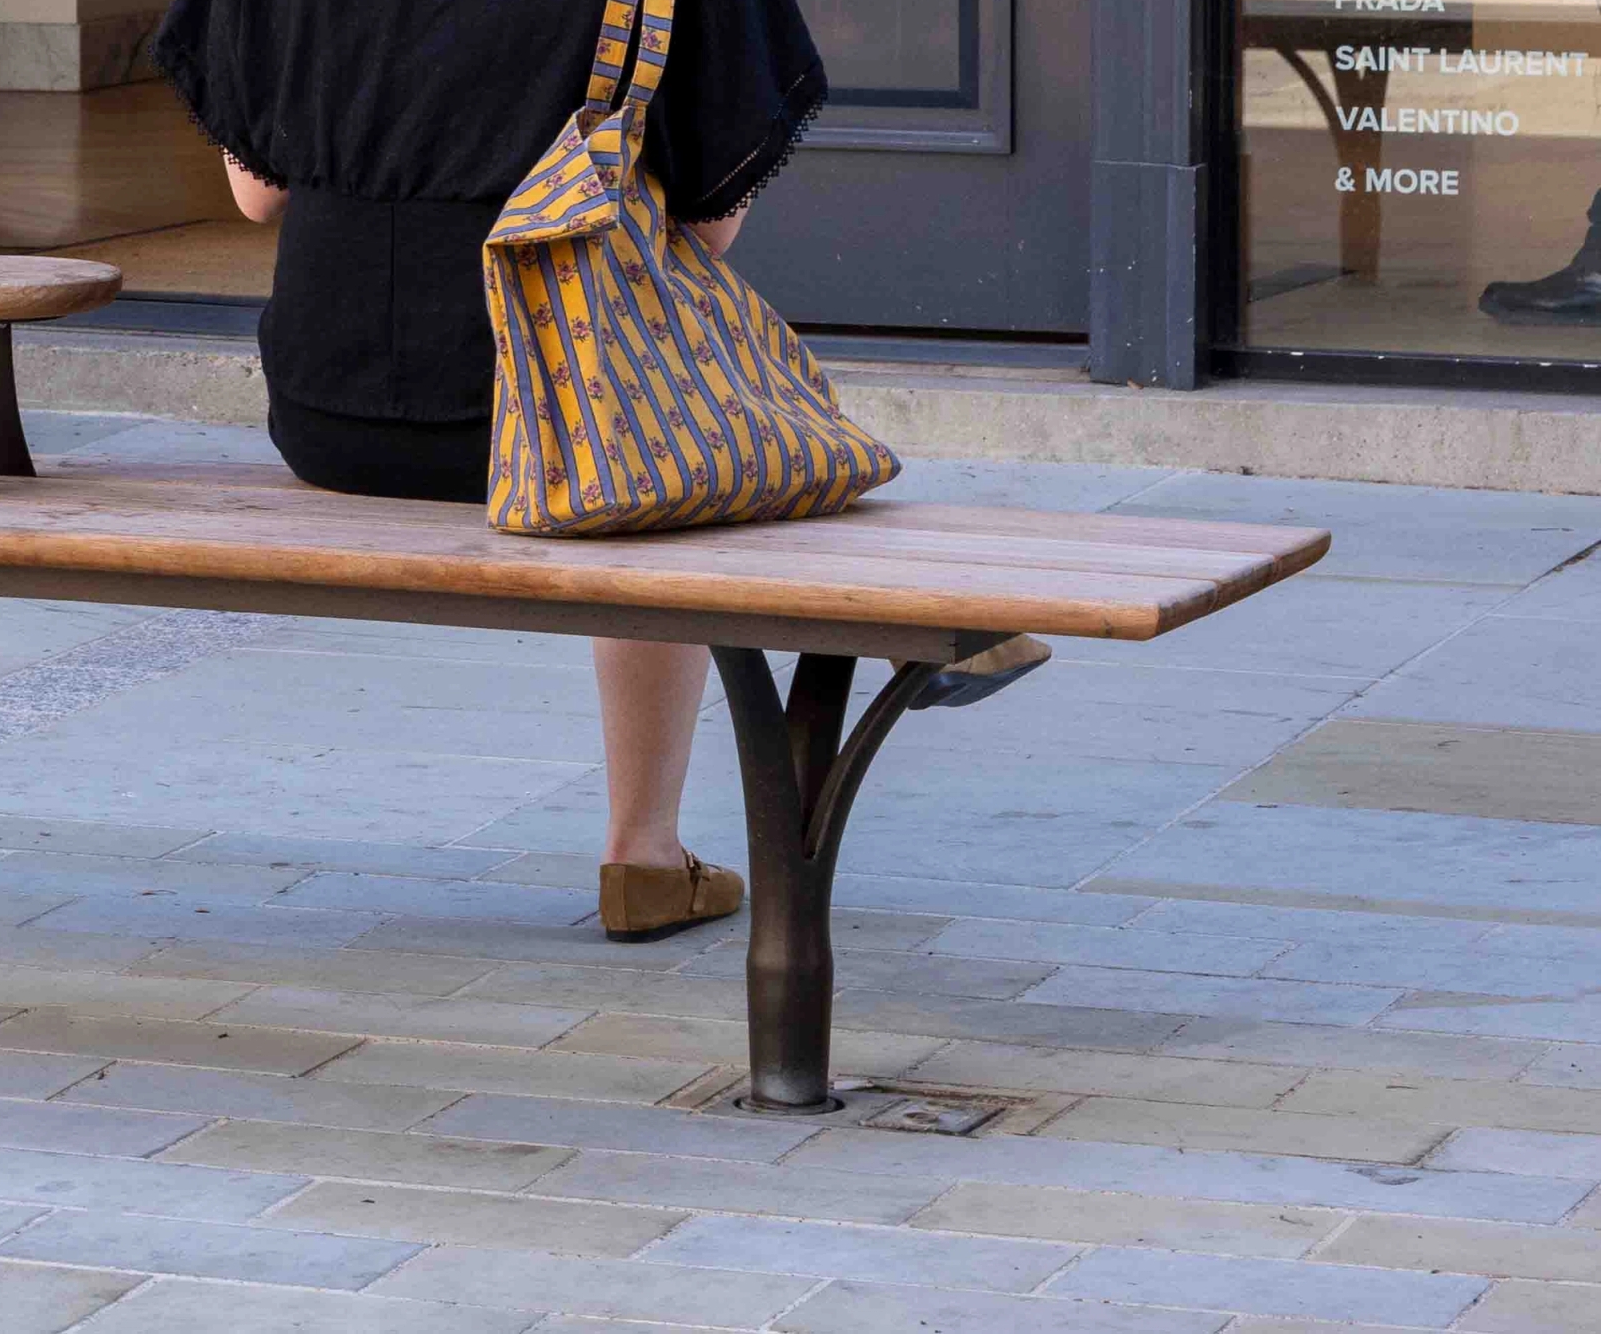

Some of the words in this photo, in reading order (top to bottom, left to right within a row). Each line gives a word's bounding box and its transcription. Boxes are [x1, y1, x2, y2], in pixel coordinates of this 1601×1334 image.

[1335, 45, 1430, 72] SAINT
[1440, 48, 1589, 77] LAURENT
[1336, 107, 1520, 137] VALENTINO
[1334, 167, 1355, 192] &
[1365, 168, 1460, 195] MORE
